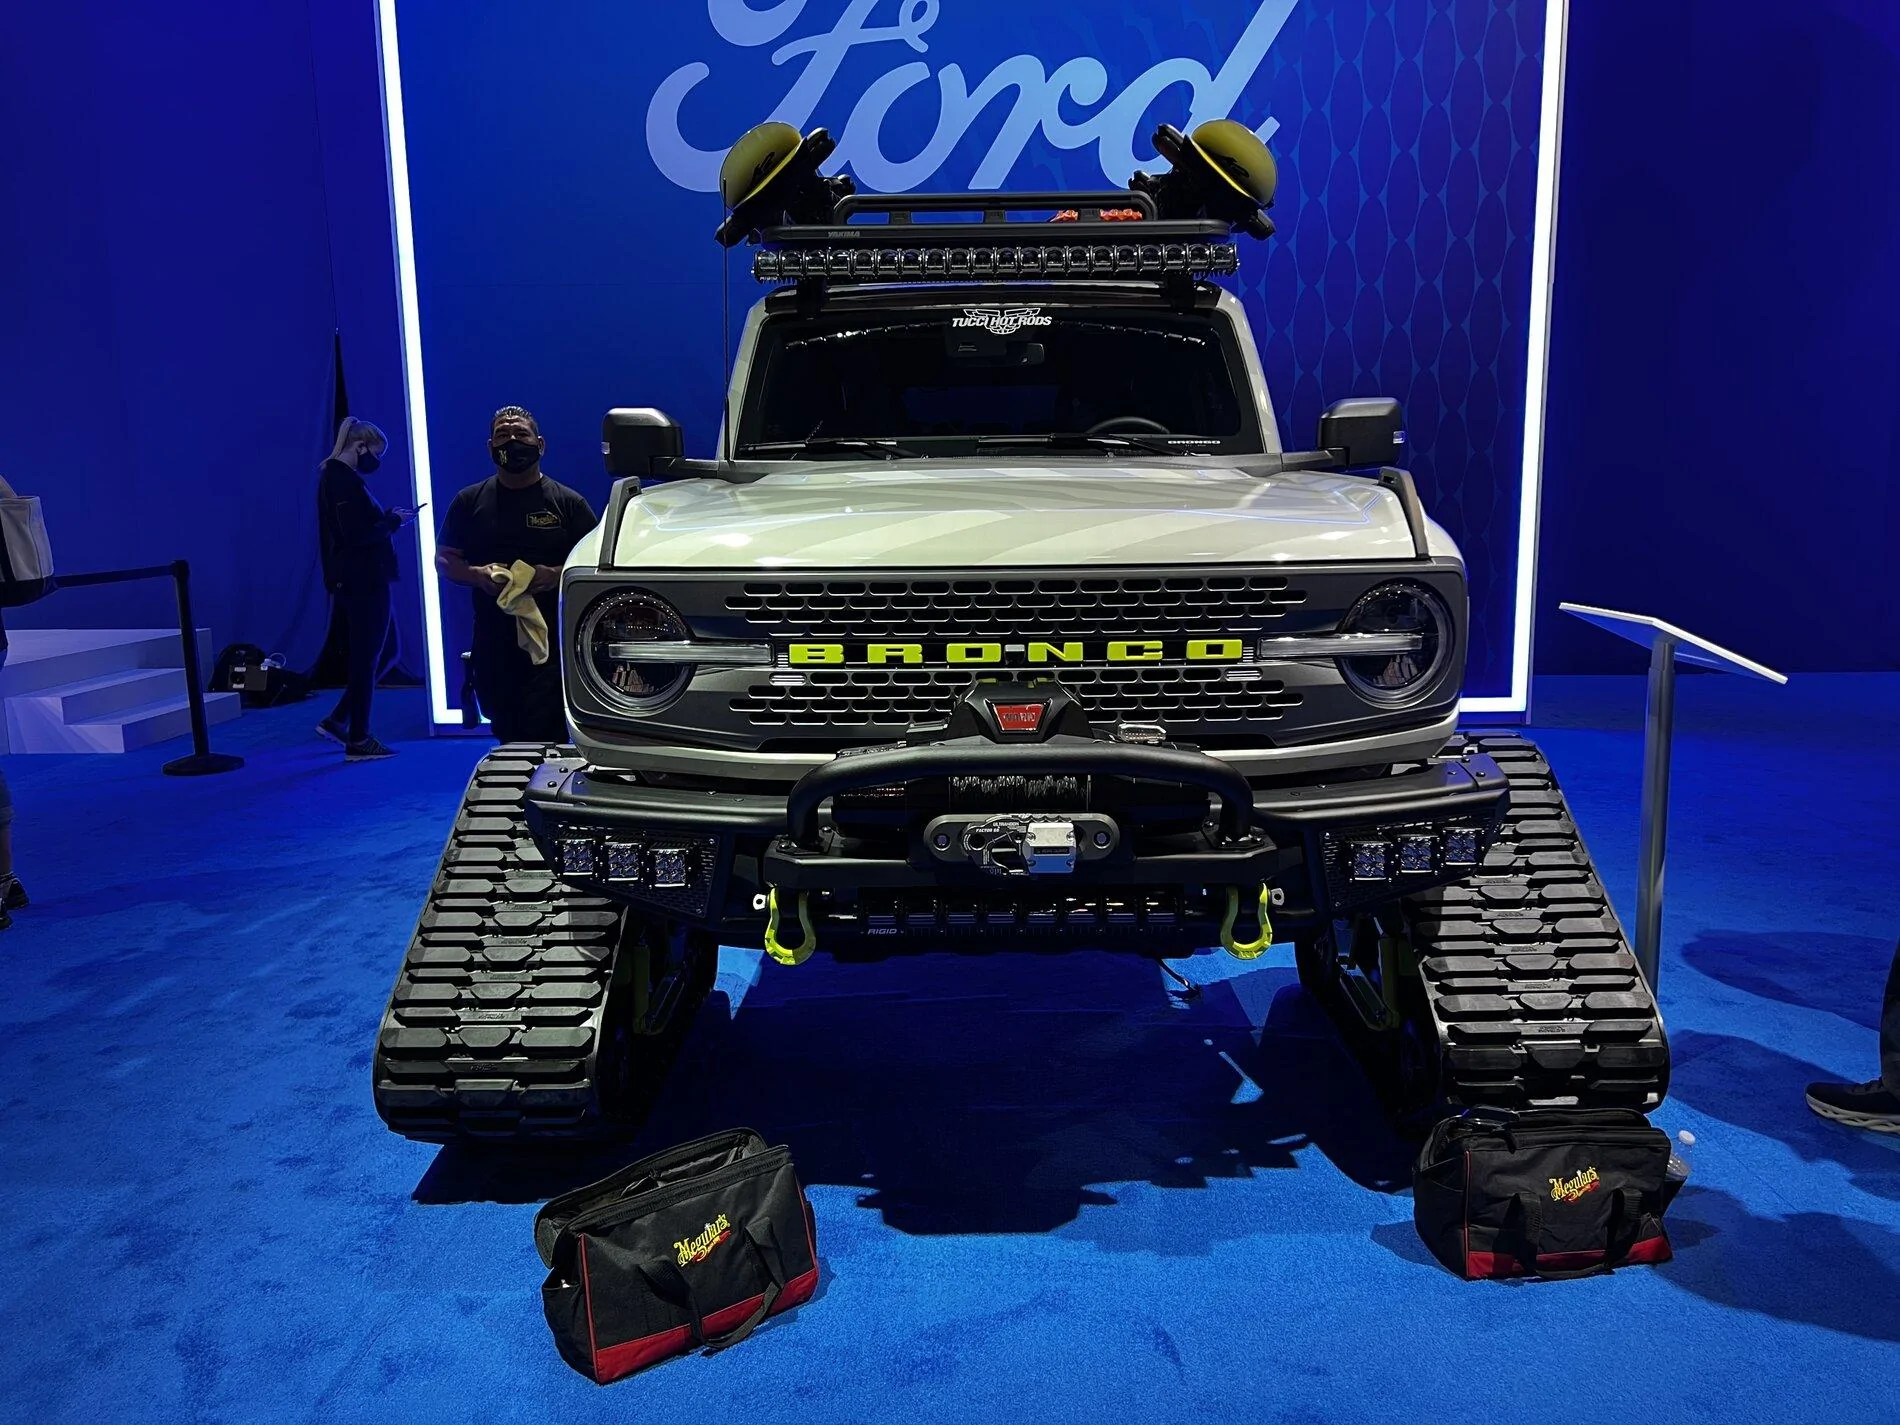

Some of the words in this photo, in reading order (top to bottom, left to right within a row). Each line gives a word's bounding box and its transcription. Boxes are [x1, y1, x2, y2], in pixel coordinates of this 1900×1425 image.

[645, 0, 1300, 193] Ford
[952, 316, 986, 328] TUCCI
[989, 316, 1017, 327] HOT
[1017, 316, 1053, 327] RODS
[788, 638, 1243, 664] BRONCO
